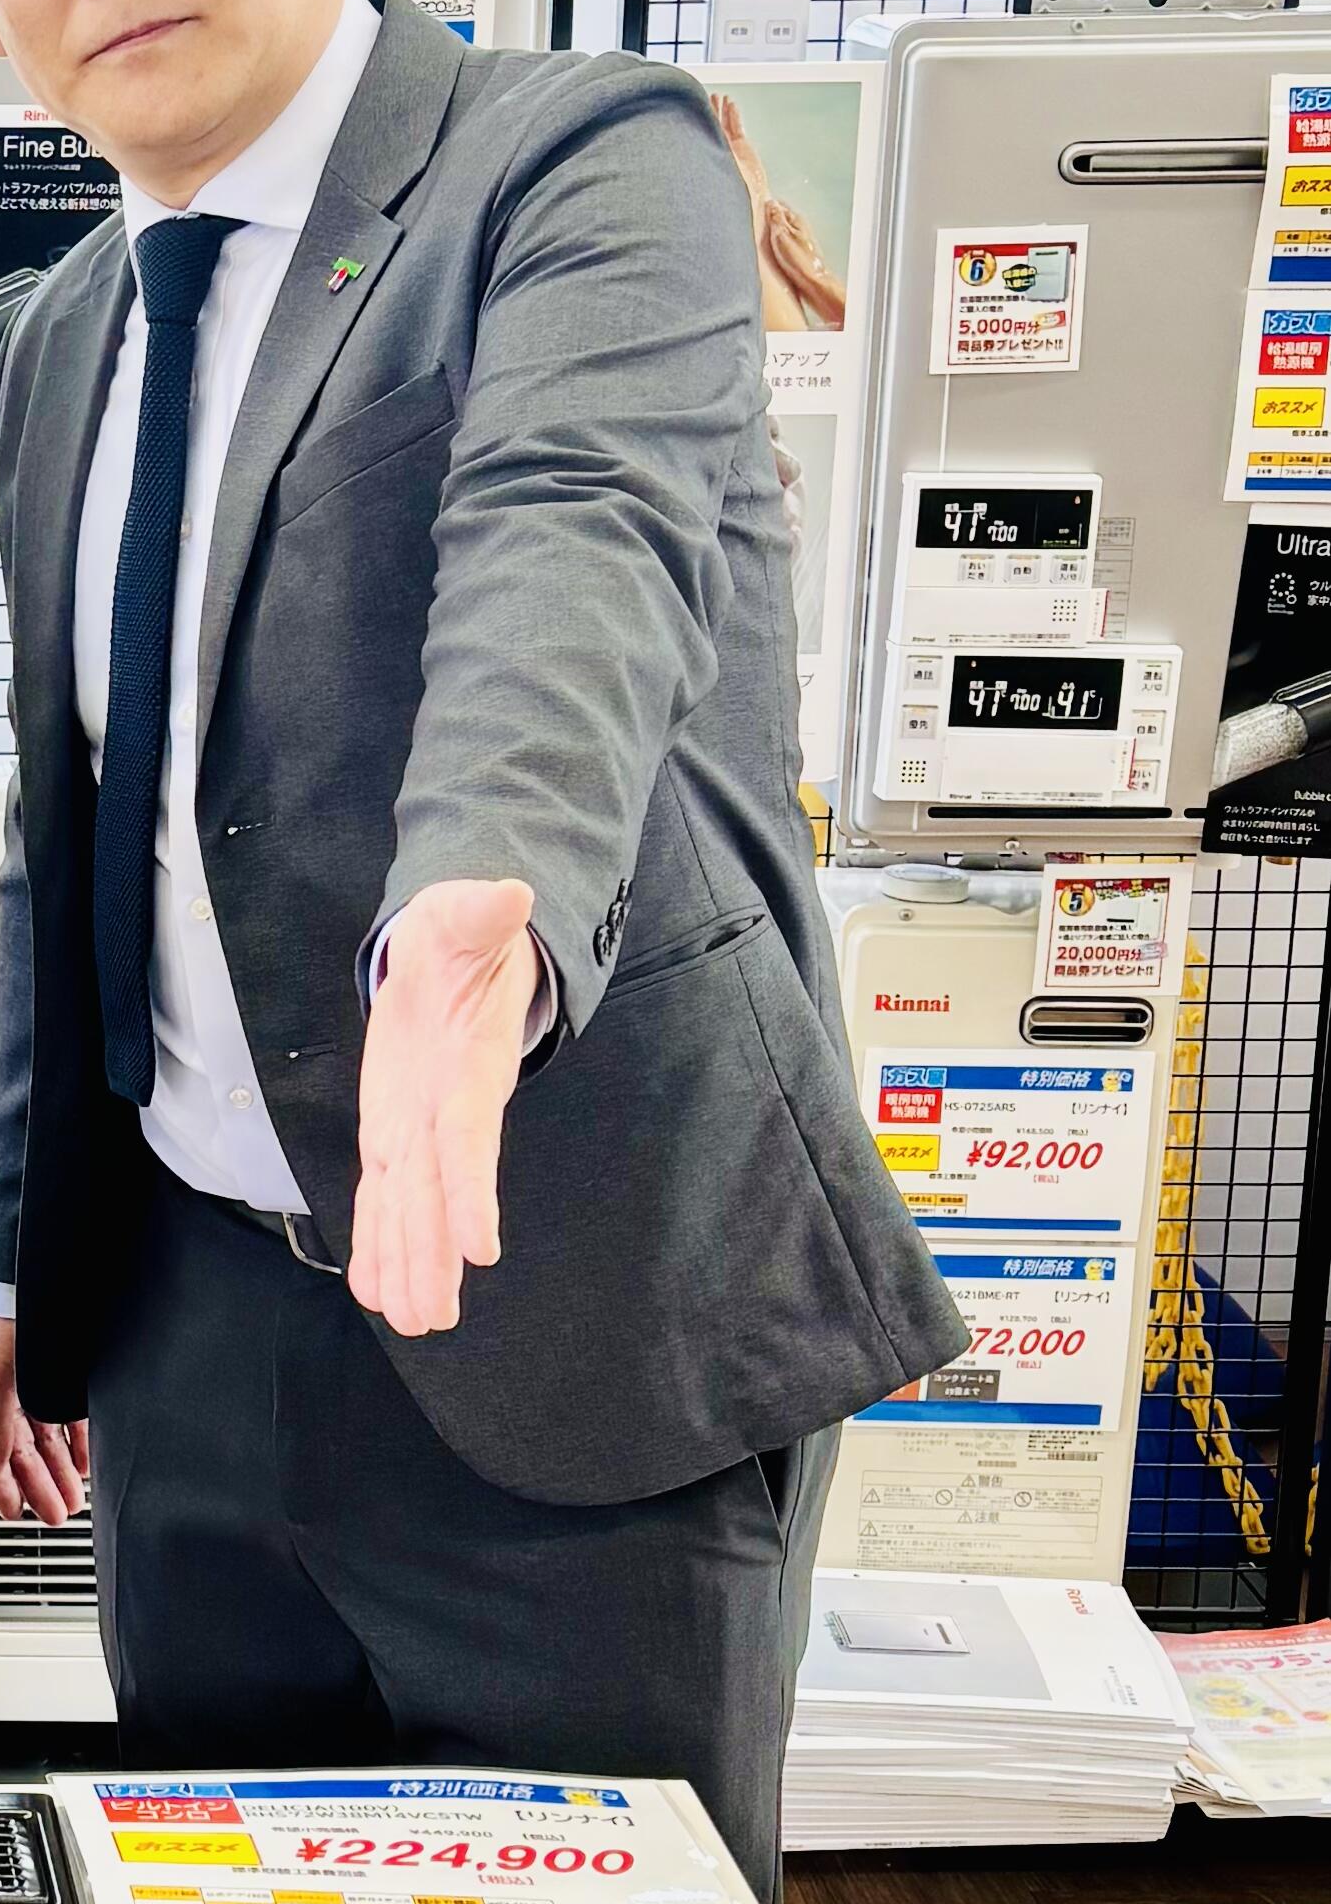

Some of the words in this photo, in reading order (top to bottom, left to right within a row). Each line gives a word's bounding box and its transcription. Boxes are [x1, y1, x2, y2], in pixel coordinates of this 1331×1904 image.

[3, 135, 55, 158] Fine
[970, 258, 986, 282] 6
[958, 318, 1040, 337] 5,000円分
[1267, 341, 1322, 356] 給湯暖房
[1273, 355, 1315, 370] 熱源機
[1262, 402, 1319, 415] おススメ
[1277, 532, 1331, 557] Ultra
[1136, 724, 1158, 735] 自動
[1069, 892, 1083, 912] 5
[1056, 946, 1142, 963] 20,000円分
[874, 992, 950, 1015] Rinnai
[1020, 1069, 1092, 1089] 特別価格
[884, 1093, 936, 1107] 暖房専用
[891, 1106, 930, 1120] 熱源機
[1070, 1102, 1129, 1116] 【リンナイ】
[883, 1146, 934, 1159] おススメ
[966, 1139, 1104, 1171] ¥92,000
[1003, 1258, 1074, 1277] 特別価格
[1051, 1290, 1113, 1304] 【リンナイ】
[387, 1780, 536, 1798] 特別価格
[109, 1799, 229, 1813] ビルトイン
[137, 1810, 212, 1821] コンロ
[515, 1809, 636, 1827] 【リンナイ】
[134, 1840, 241, 1853] おススメ
[295, 1837, 635, 1875] ¥224,900
